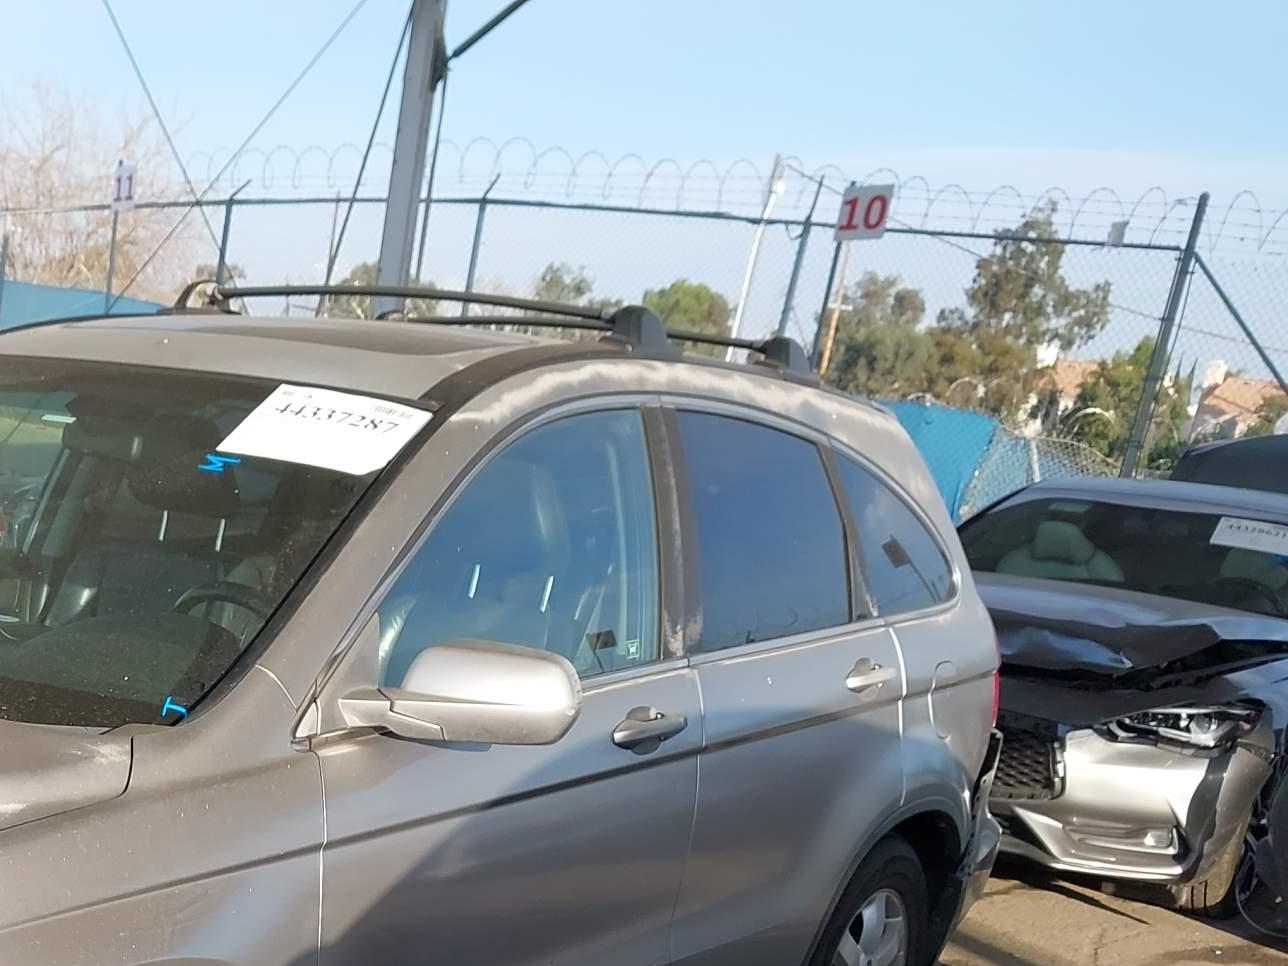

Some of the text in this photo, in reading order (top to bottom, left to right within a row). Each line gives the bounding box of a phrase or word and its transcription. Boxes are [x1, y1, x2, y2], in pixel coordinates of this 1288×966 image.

[113, 174, 134, 202] 11
[839, 194, 888, 230] 10
[274, 402, 400, 434] 44337287
